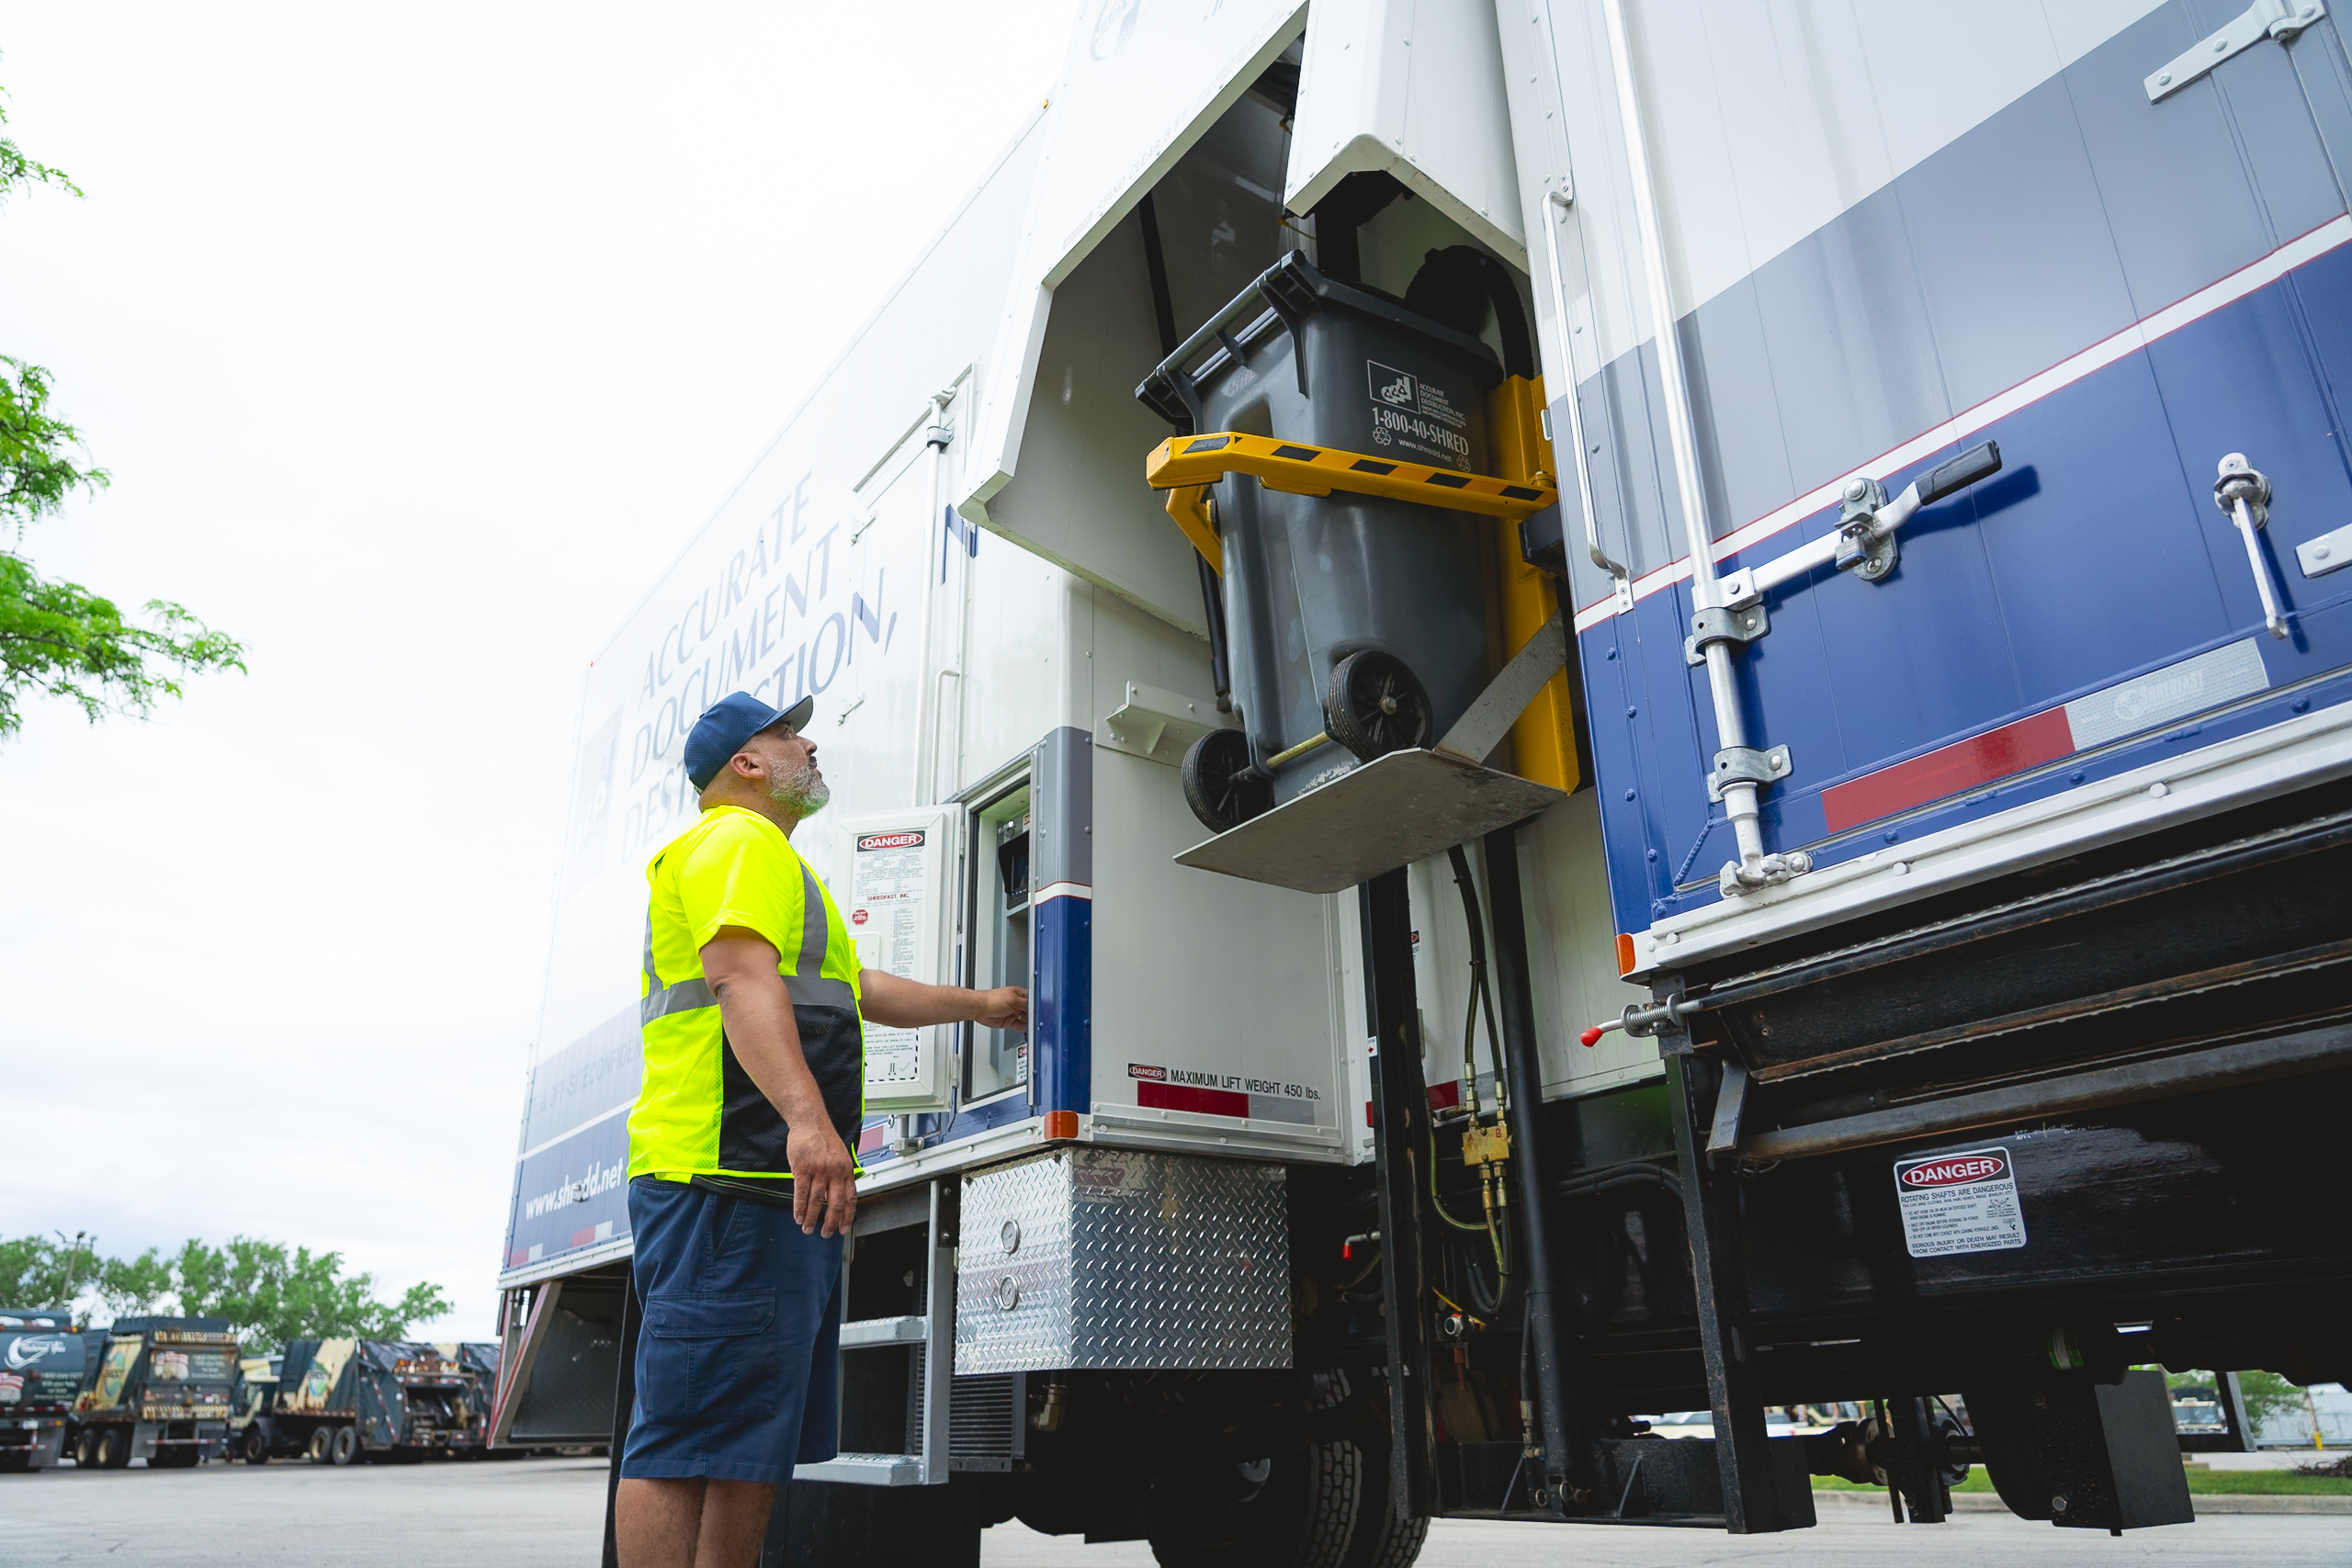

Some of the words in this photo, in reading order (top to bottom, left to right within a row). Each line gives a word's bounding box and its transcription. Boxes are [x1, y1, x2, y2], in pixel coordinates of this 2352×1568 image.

[1420, 384, 1444, 398] ACCURATE
[1420, 390, 1448, 405] DOCUMENT
[1372, 407, 1469, 456] 1-800-40-SHRED
[1398, 438, 1453, 463] www.shredd.net
[637, 468, 813, 712] ACCURATE
[629, 521, 840, 787] DOCUMENT
[864, 835, 917, 849] DANGER
[1132, 1066, 1163, 1077] DANGER
[1170, 1069, 1218, 1087] MAXIMUM
[1221, 1076, 1241, 1090] LIFT
[1244, 1078, 1281, 1095] WEIGHT
[1284, 1084, 1302, 1098] 450
[1306, 1086, 1321, 1100] lbs.
[1911, 1159, 1994, 1183] DANGER
[525, 1156, 624, 1220] www.shrdd.net
[1901, 1193, 1928, 1202] ROTATING
[1930, 1190, 1955, 1199] SHAFTS
[1973, 1182, 2013, 1194] DANGEROUS
[1970, 1240, 2002, 1248] ENERGIZED
